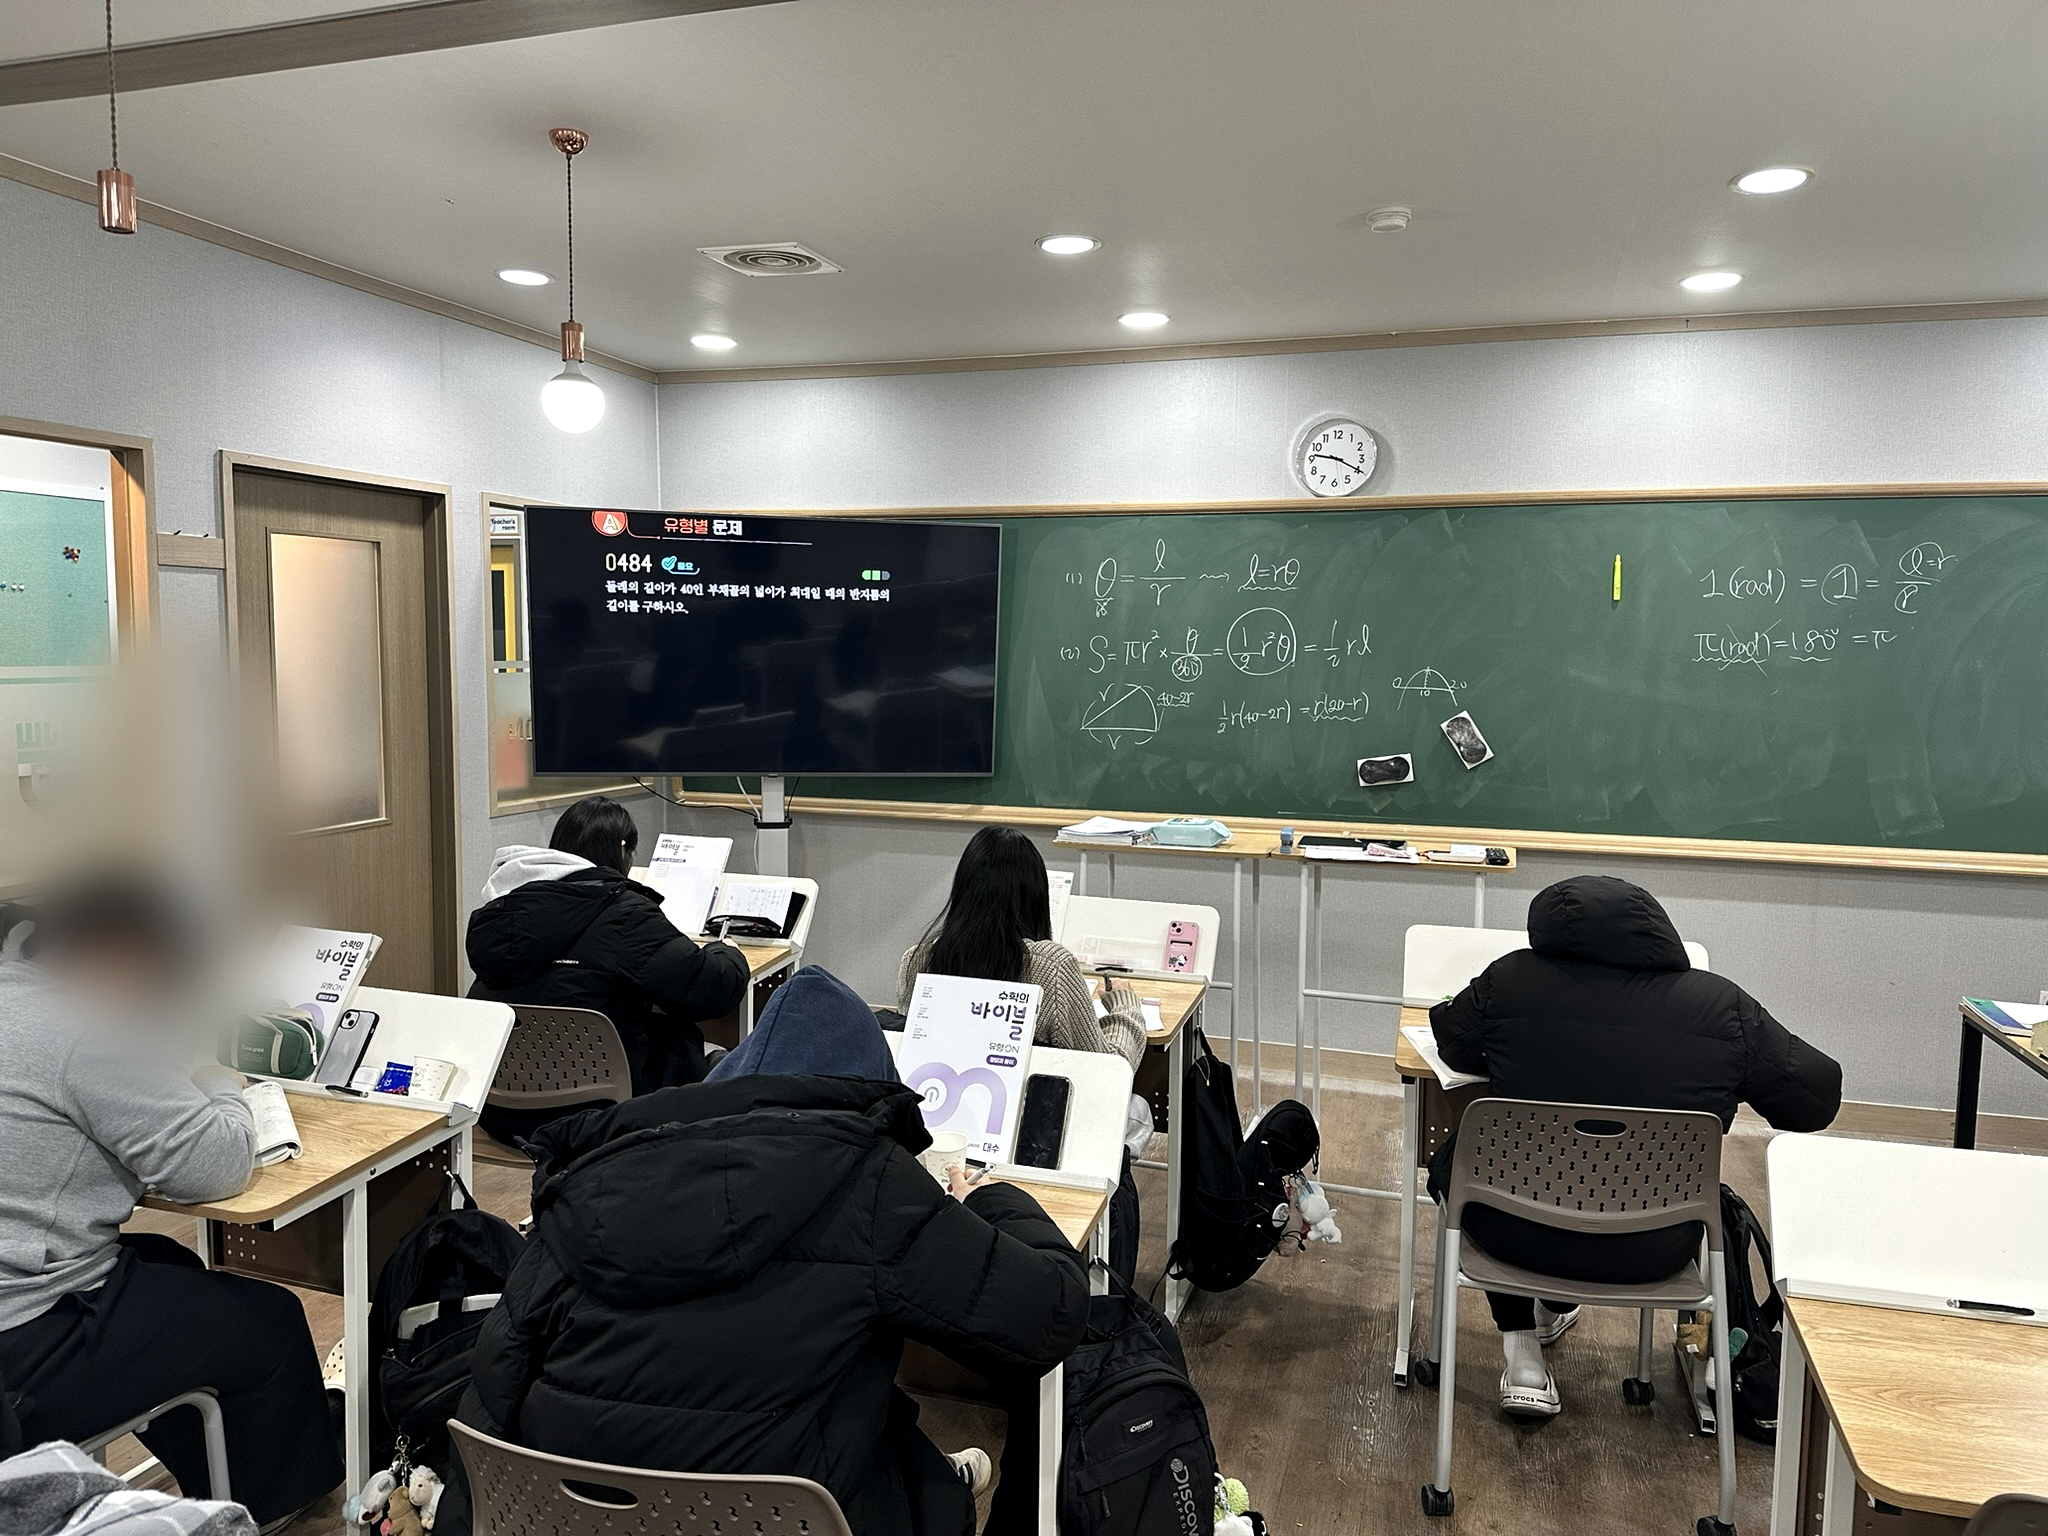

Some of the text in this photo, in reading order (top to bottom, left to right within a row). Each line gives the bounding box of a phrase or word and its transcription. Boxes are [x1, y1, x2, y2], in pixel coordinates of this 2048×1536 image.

[1322, 434, 1329, 443] 11
[1333, 430, 1344, 440] 12
[1349, 433, 1354, 443] 1
[1312, 442, 1322, 452] 10
[1356, 442, 1364, 452] 2
[1308, 454, 1315, 464] 9
[1358, 454, 1365, 463] 3
[1310, 466, 1317, 475] 8
[1320, 475, 1326, 484] 7
[1331, 478, 1338, 487] 6
[1344, 475, 1351, 484] 5
[602, 513, 618, 531] A
[664, 517, 743, 536] 유형별 문제
[605, 552, 652, 573] 0484
[643, 581, 677, 596] 길이가
[680, 583, 704, 596] 40인
[707, 583, 750, 598] 부채꼴의
[790, 586, 821, 600] 최대일
[849, 588, 890, 602] 반지름의
[606, 599, 689, 614] 길이를 구하시오.
[340, 940, 364, 950] 수학의
[316, 949, 359, 981] 바이블
[998, 991, 1030, 1003] 수학의
[971, 1001, 1027, 1041] 바이블
[989, 1042, 1020, 1053] 유형ON
[983, 1143, 999, 1153] 대수
[1512, 1394, 1535, 1403] crocs
